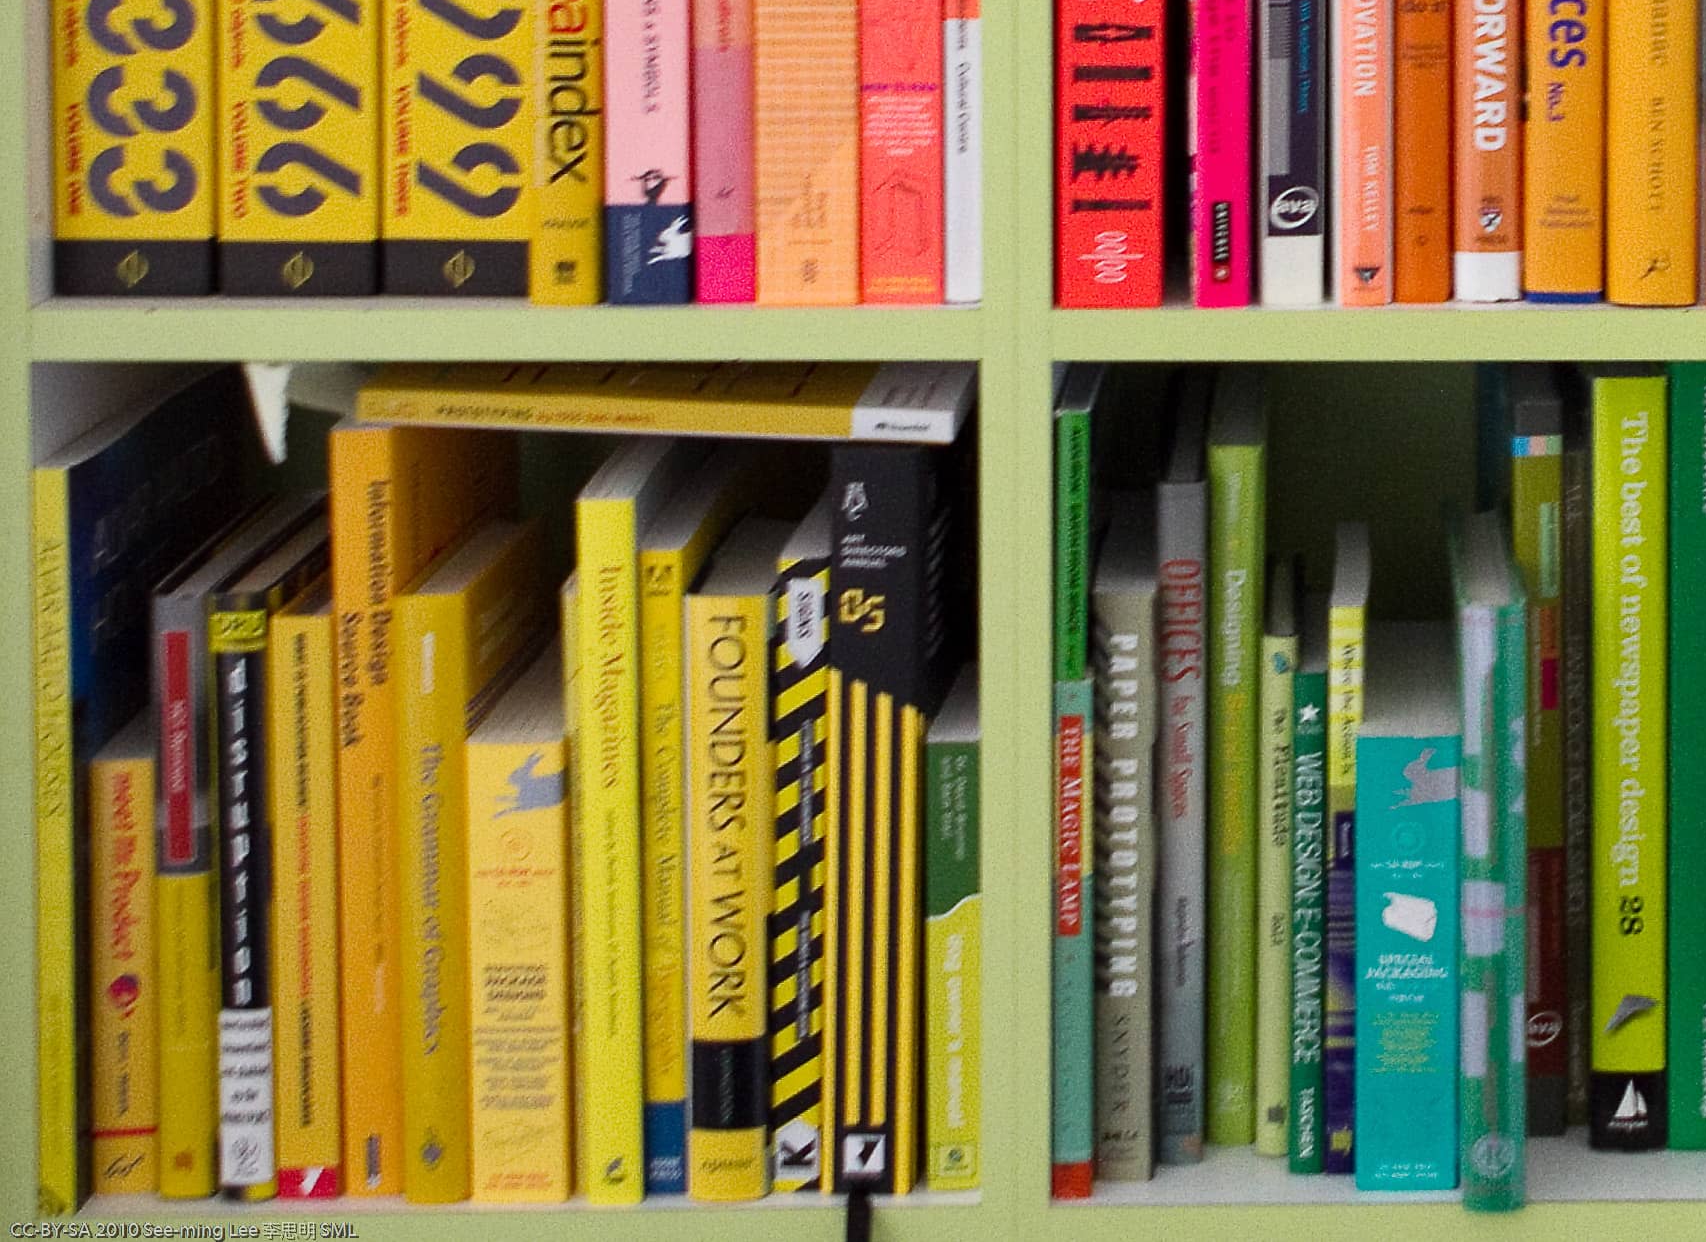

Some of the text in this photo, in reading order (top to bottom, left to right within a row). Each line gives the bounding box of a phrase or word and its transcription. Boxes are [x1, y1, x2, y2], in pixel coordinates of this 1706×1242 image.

[1160, 561, 1200, 682] OFFICES
[1294, 751, 1321, 805] WEB
[1611, 412, 1649, 936] The best of newspaper design 28
[707, 614, 747, 1019] FOUNDERS AT WORK
[1109, 635, 1138, 996] PAPER PROTOTYPING
